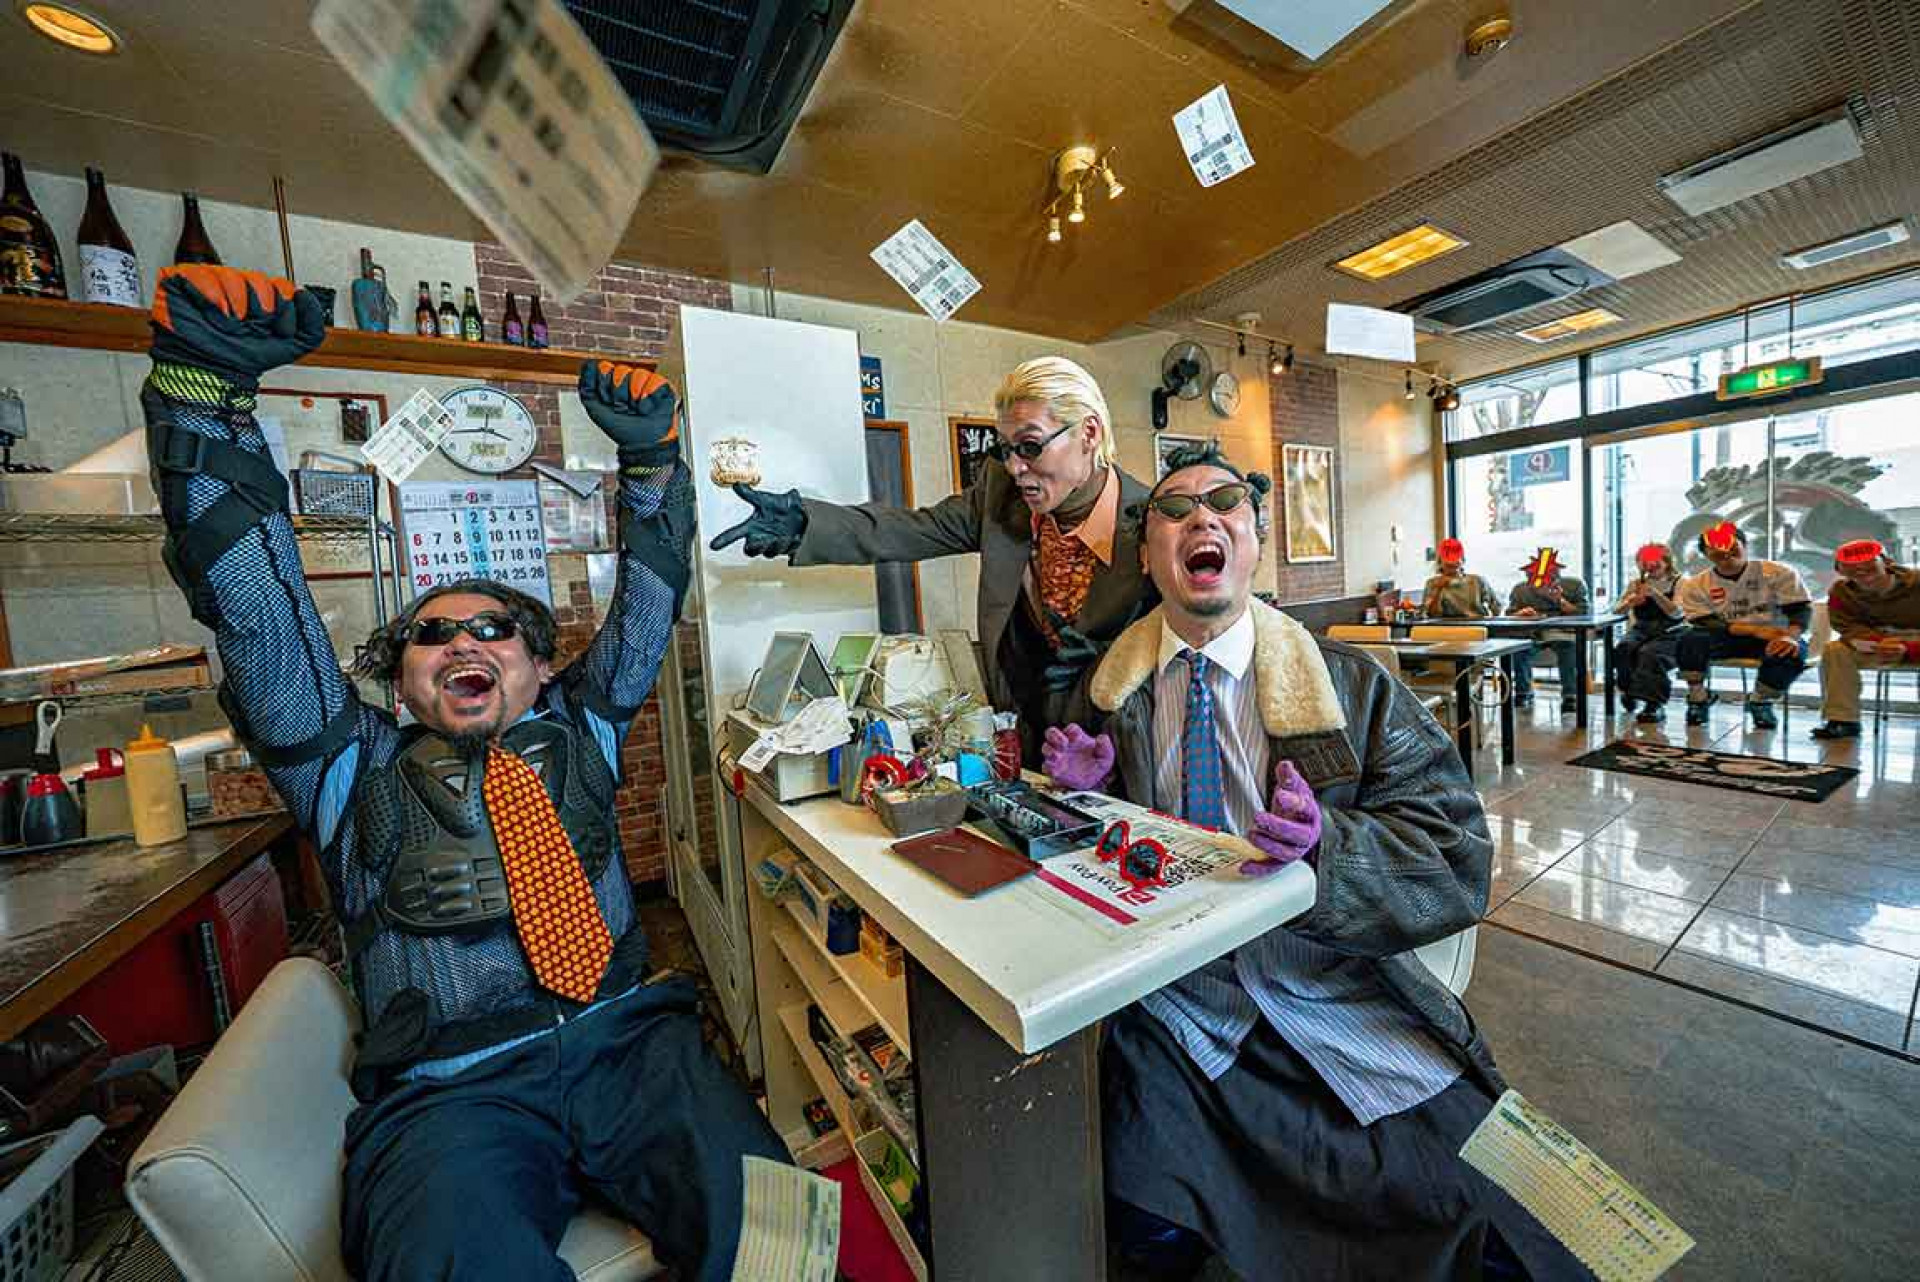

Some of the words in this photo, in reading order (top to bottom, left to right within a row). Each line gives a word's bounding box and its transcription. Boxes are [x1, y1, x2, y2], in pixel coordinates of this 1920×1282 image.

[452, 513, 457, 524] 1
[470, 511, 478, 522] 2
[489, 510, 497, 522] 3
[508, 510, 516, 521] 4
[525, 511, 533, 522] 5
[414, 534, 422, 546] 6
[434, 533, 441, 544] 7
[454, 533, 461, 544] 8
[472, 532, 481, 543] 9
[489, 531, 503, 542] 10
[508, 530, 521, 541] 11
[526, 530, 539, 540] 12
[414, 554, 429, 567] 13
[434, 553, 448, 565] 14
[454, 552, 468, 563] 15
[473, 551, 487, 562] 16
[492, 550, 504, 561] 17
[511, 549, 524, 560] 18
[528, 548, 542, 559] 19
[416, 574, 431, 586] 20
[437, 574, 451, 585] 21
[494, 569, 508, 580] 24
[511, 568, 526, 579] 25
[531, 567, 544, 578] 26
[1070, 864, 1127, 892] PayPay
